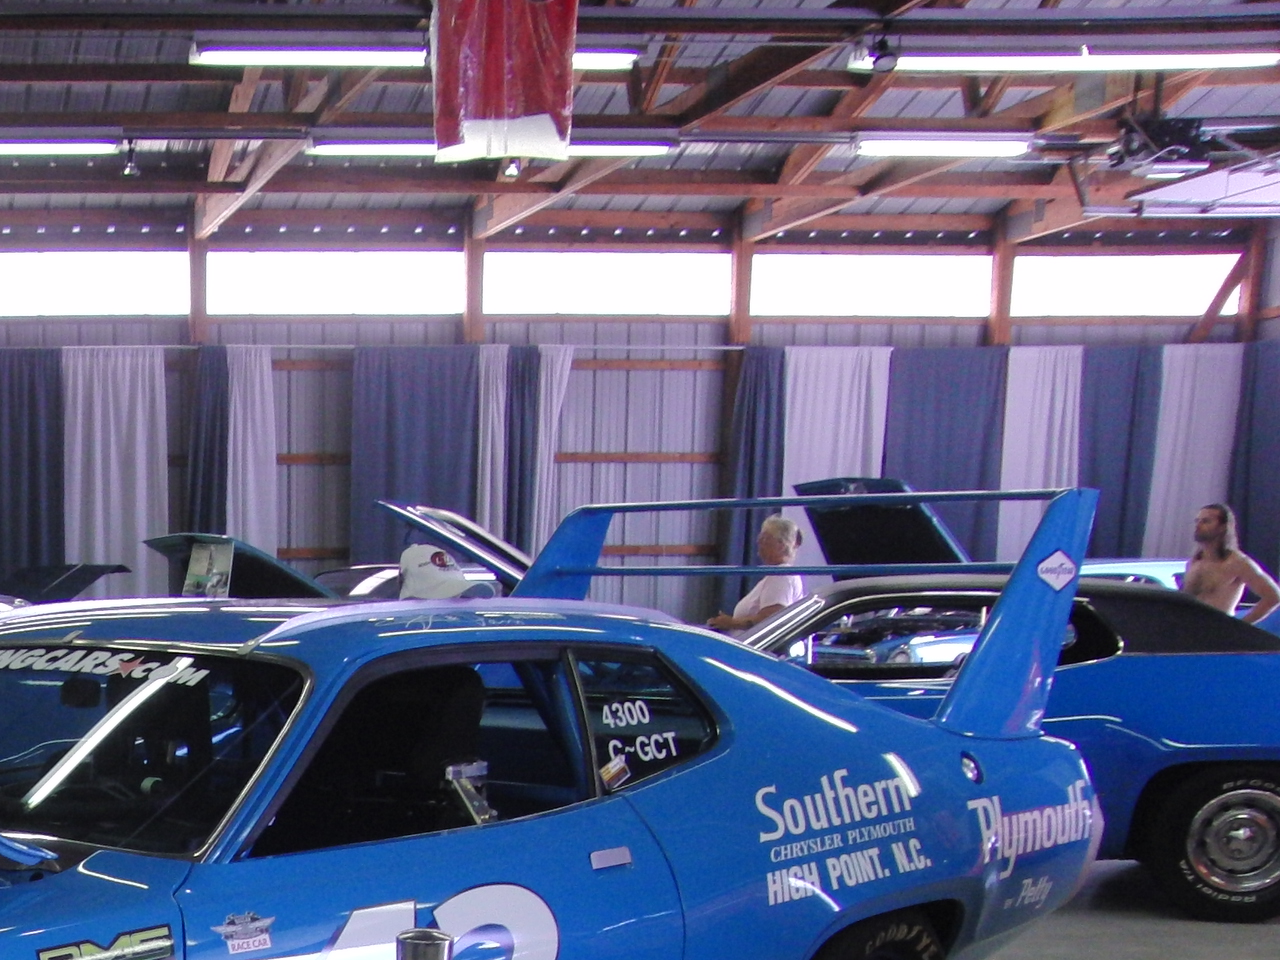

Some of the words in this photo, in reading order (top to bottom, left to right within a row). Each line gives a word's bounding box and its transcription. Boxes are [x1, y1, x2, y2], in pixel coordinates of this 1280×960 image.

[603, 700, 650, 728] 4300
[755, 768, 912, 843] Southern
[967, 779, 1092, 880] Plymouth
[771, 832, 844, 863] CHRYSLER
[847, 817, 916, 845] PLYMOUTH
[766, 861, 822, 906] HIGH
[891, 837, 933, 873] N.C.
[231, 941, 251, 952] RACE
[253, 938, 269, 948] CAR
